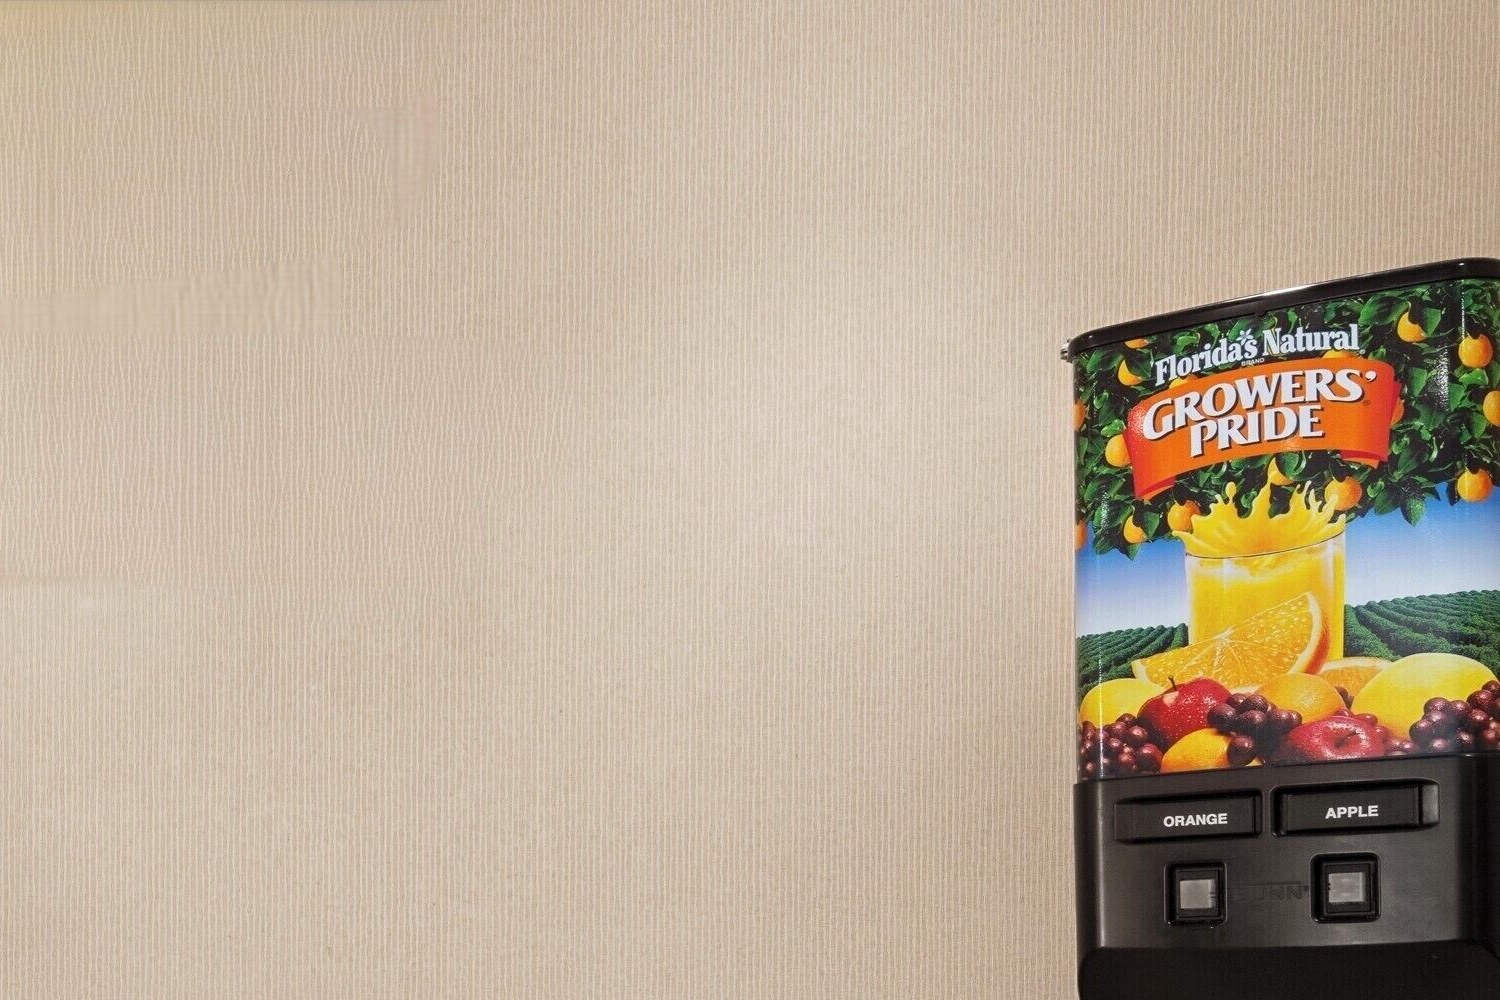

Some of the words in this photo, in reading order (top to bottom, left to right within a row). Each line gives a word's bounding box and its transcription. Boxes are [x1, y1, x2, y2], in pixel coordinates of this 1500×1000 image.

[1155, 329, 1259, 387] Florida's
[1262, 324, 1360, 357] Natural
[1241, 357, 1265, 367] BRAND
[1190, 404, 1324, 458] PRIDE
[1325, 805, 1379, 819] APPLE
[1163, 813, 1228, 828] ORANGE
